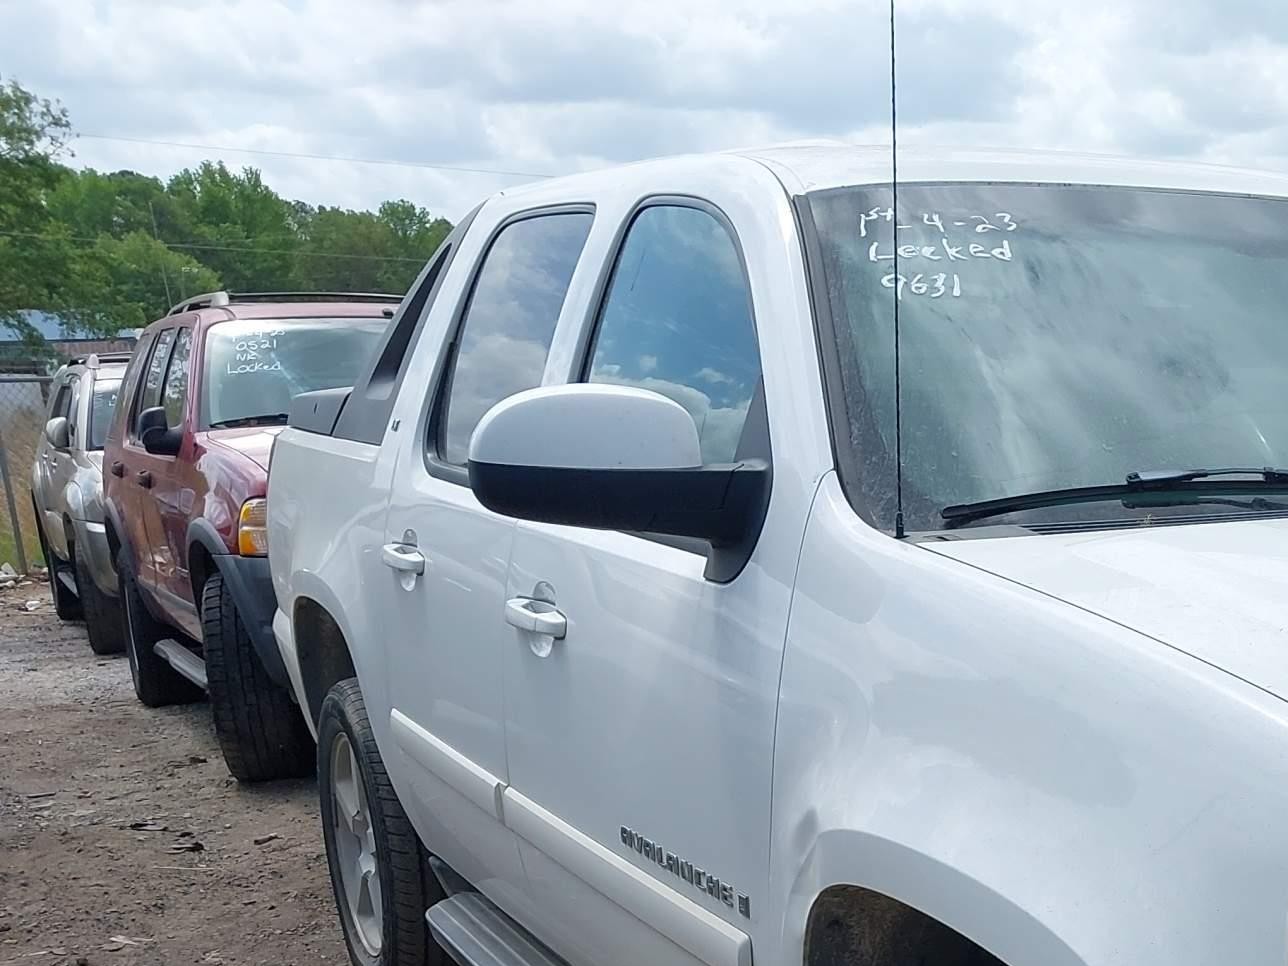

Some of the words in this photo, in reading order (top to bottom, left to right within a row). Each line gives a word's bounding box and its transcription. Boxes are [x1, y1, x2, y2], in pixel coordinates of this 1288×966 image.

[880, 271, 962, 300] 9631
[235, 338, 277, 352] 0521
[227, 360, 281, 375] Locked
[619, 824, 735, 909] AVALANCHE
